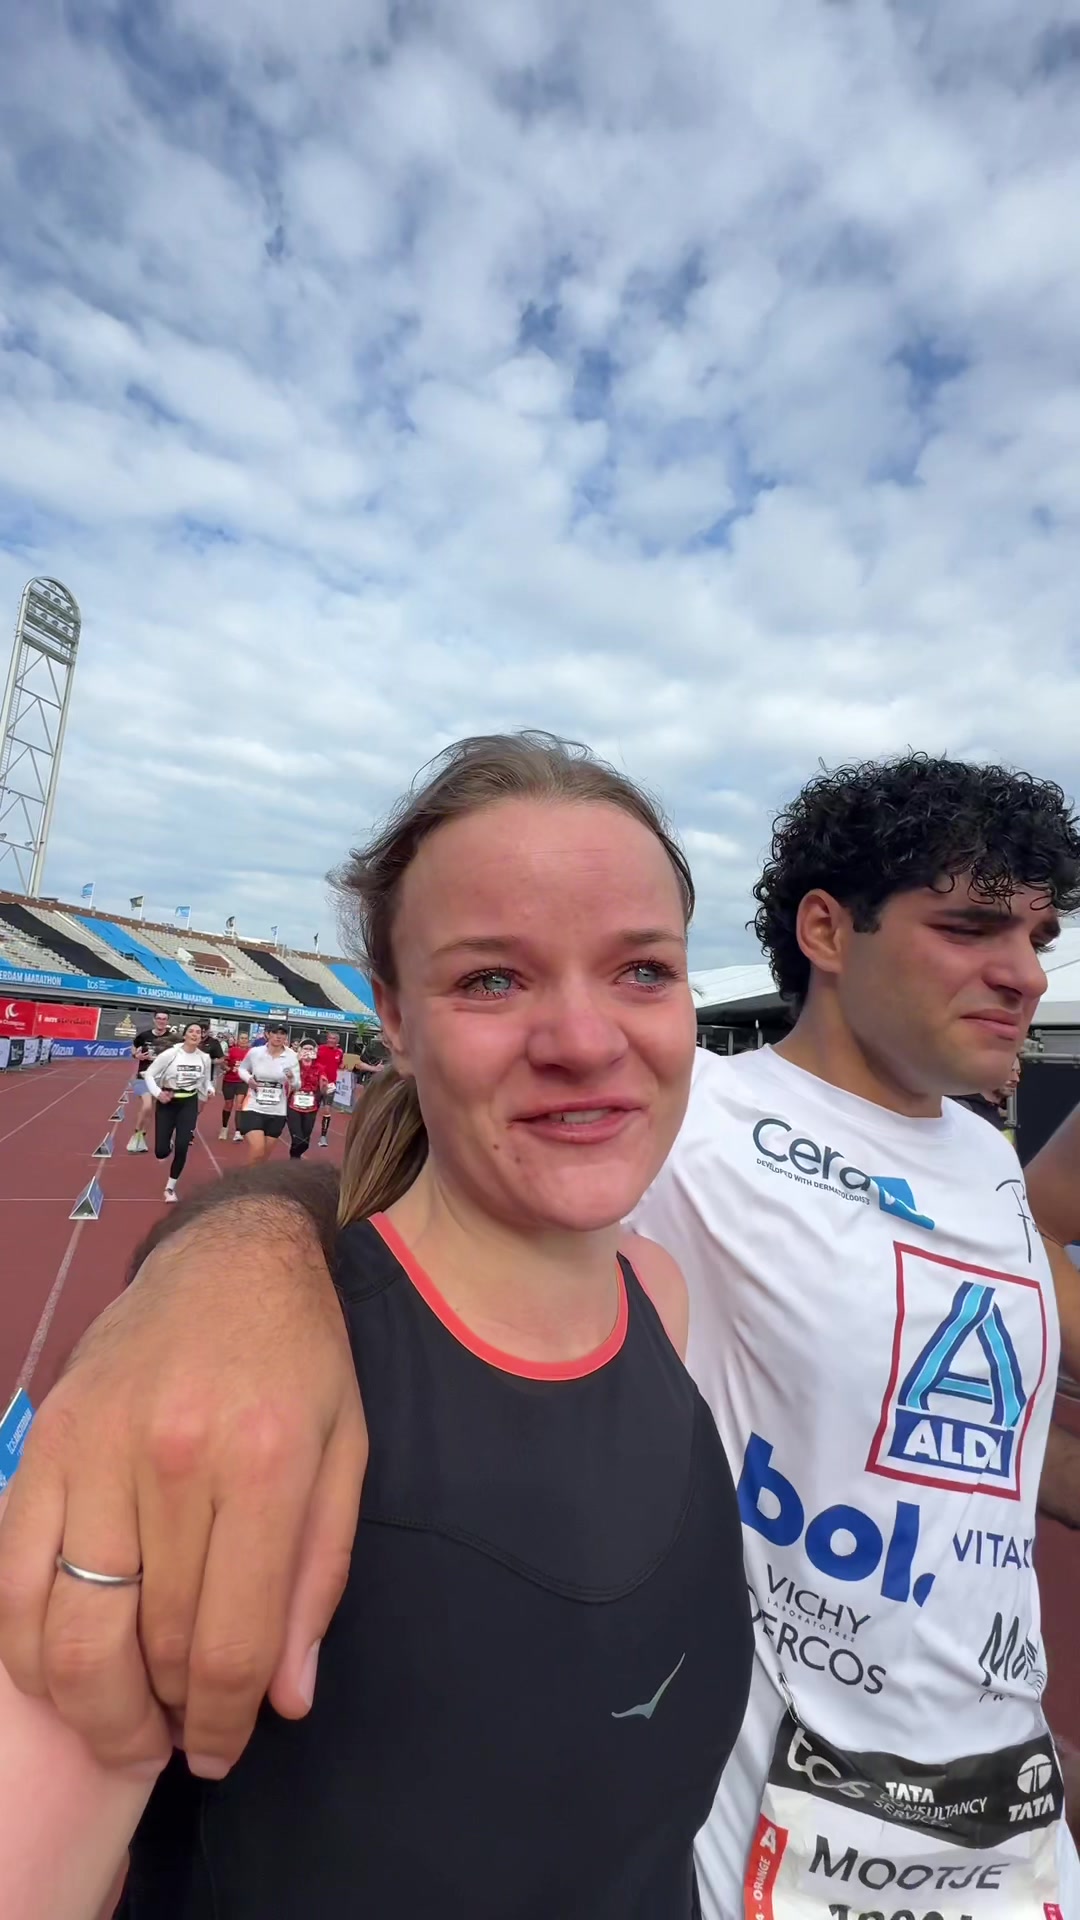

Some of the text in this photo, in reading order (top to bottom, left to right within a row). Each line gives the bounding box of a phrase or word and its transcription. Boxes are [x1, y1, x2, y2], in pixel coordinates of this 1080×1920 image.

[24, 973, 61, 986] MARATHON
[137, 986, 213, 1004] TCS AMSTERDAM MARATHON
[756, 1158, 793, 1179] DEVELOPED
[793, 1174, 813, 1187] WITH
[903, 1419, 1004, 1471] ALDI
[736, 1431, 936, 1608] bol.
[767, 1563, 871, 1635] VICHY
[885, 1782, 934, 1804] TATA
[1008, 1793, 1055, 1822] TATA
[752, 1855, 771, 1901] ORANGE
[809, 1834, 1011, 1890] MOOTJE
